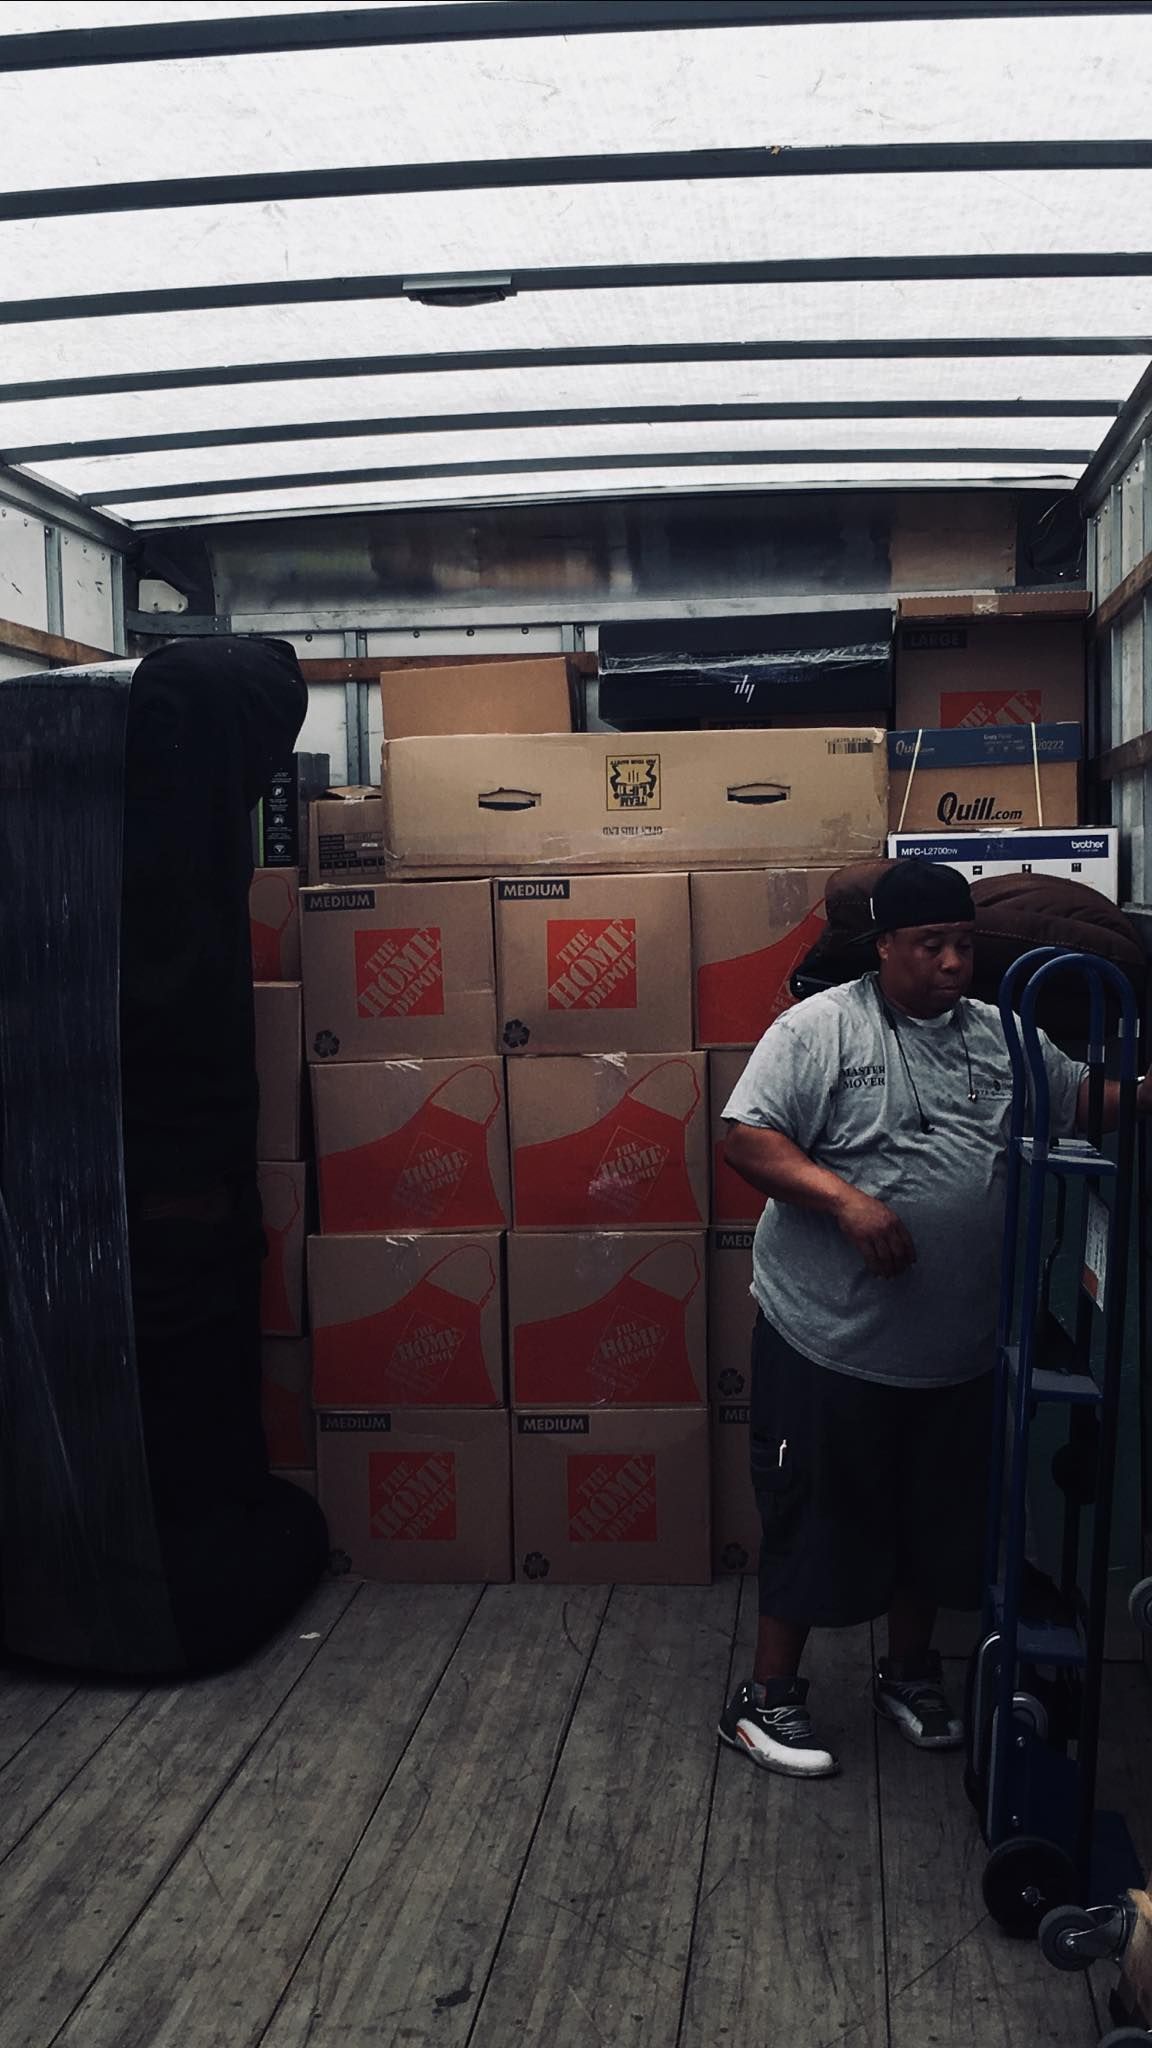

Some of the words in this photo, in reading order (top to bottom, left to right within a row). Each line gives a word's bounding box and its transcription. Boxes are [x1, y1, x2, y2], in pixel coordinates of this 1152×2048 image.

[910, 631, 960, 647] LARGE
[734, 675, 755, 703] hp
[620, 796, 648, 807] TEAM
[621, 785, 648, 796] LIFT
[937, 792, 1022, 825] Quill.com
[1071, 839, 1105, 850] brother
[309, 894, 370, 909] MEDIUM
[504, 883, 565, 897] MEDIUM
[365, 938, 399, 975] THE
[556, 928, 593, 966] THE
[358, 927, 441, 1017] HOME
[548, 918, 637, 1009] HOME
[391, 959, 443, 1017] DEPOT
[584, 951, 637, 1009] DEPOT
[840, 1065, 886, 1076] MASTER
[842, 1076, 886, 1089] MOVER
[600, 1145, 670, 1181] HOME
[615, 1141, 640, 1157] THE
[720, 1233, 753, 1248] MED
[325, 1416, 387, 1430] MEDIUM
[523, 1418, 585, 1432] MEDIUM
[381, 1460, 414, 1496] THE
[576, 1464, 613, 1498] THE
[370, 1451, 454, 1538] HOME
[569, 1454, 656, 1542] HOME
[604, 1488, 656, 1542] DEPOT
